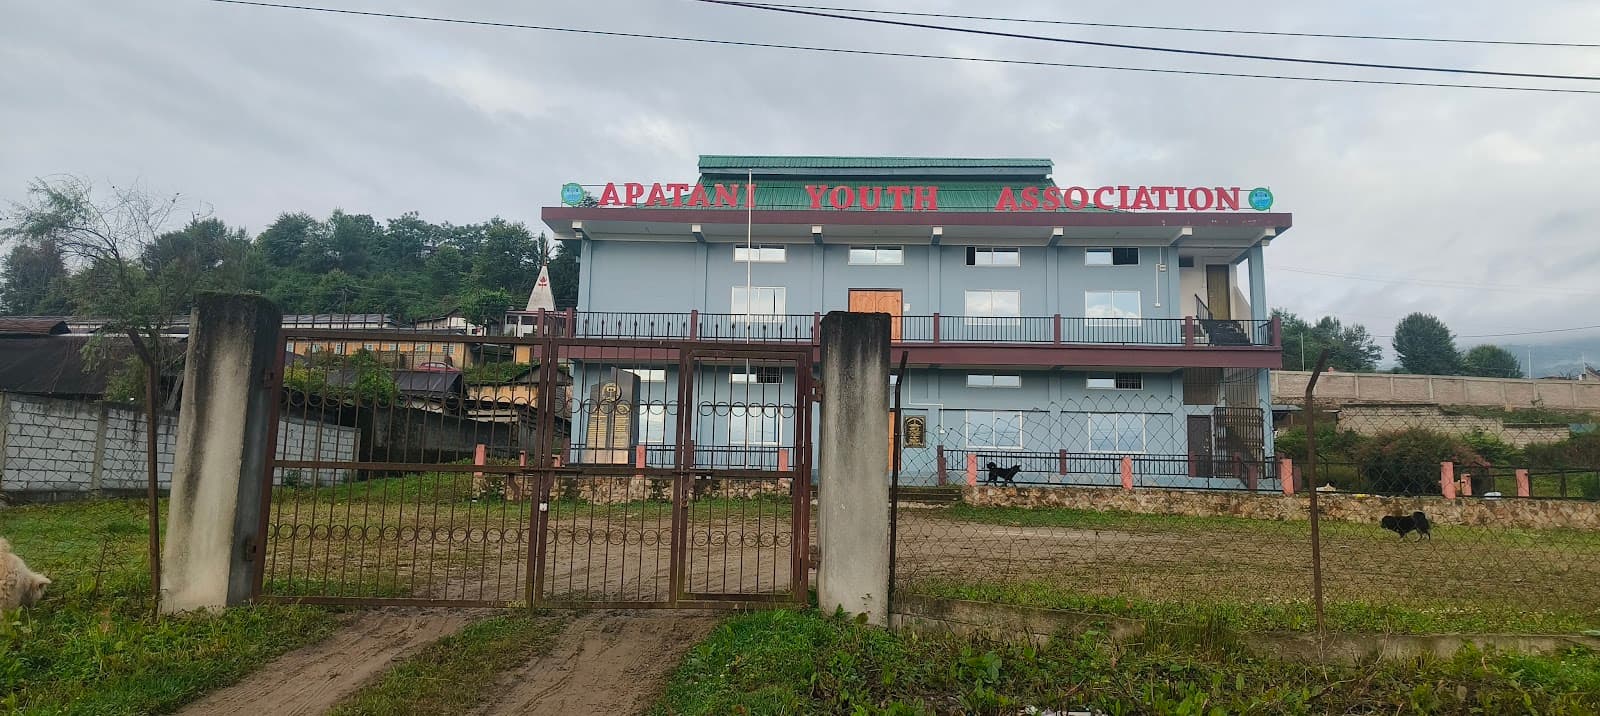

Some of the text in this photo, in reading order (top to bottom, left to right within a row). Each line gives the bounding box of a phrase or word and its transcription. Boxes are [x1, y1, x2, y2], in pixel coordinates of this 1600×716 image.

[598, 182, 1241, 211] APATANI YOUTH ASSOCIATION
